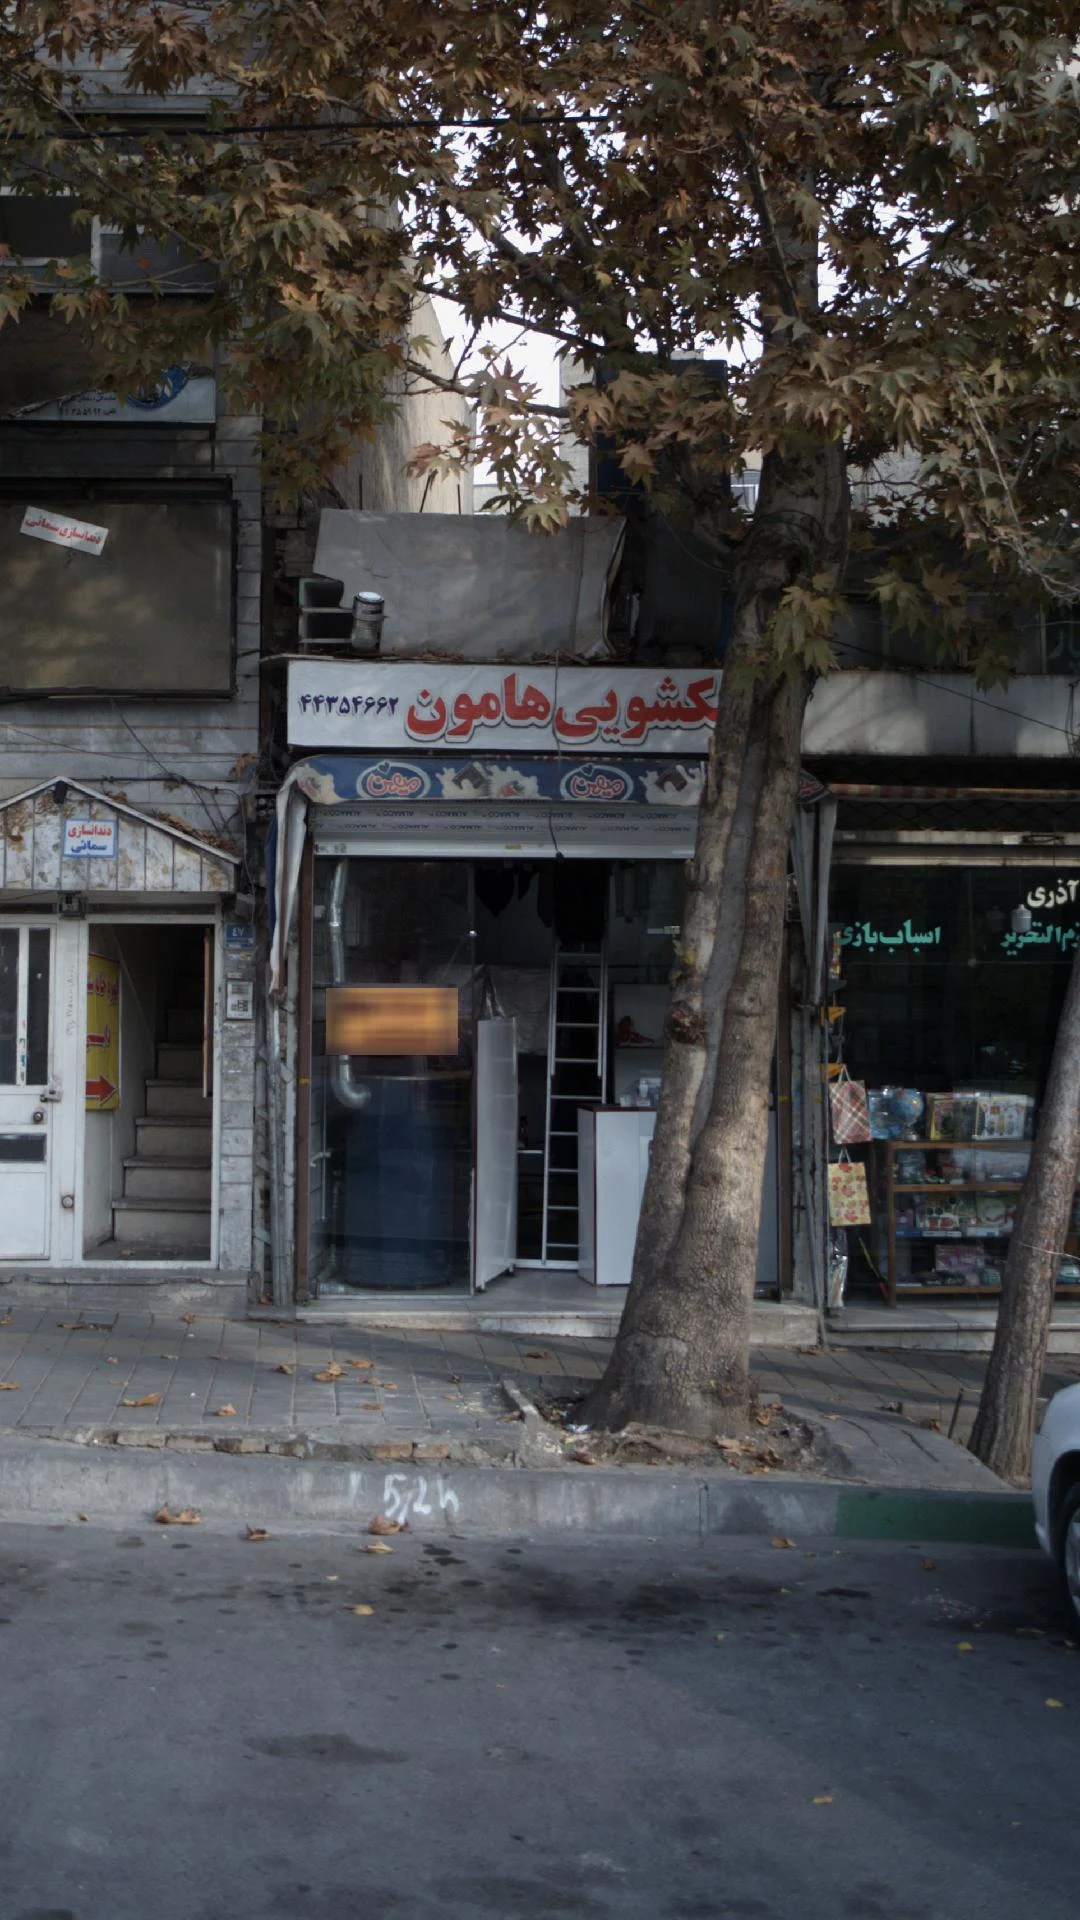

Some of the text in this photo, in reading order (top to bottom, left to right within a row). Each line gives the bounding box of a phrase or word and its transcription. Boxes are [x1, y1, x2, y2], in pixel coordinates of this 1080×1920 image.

[299, 673, 718, 742] کشویی هامون ۴۴۳۵۴۶۶۲
[67, 823, 113, 838] دندانسازی
[1026, 877, 1080, 909] آذری
[879, 918, 942, 954] اسباب
